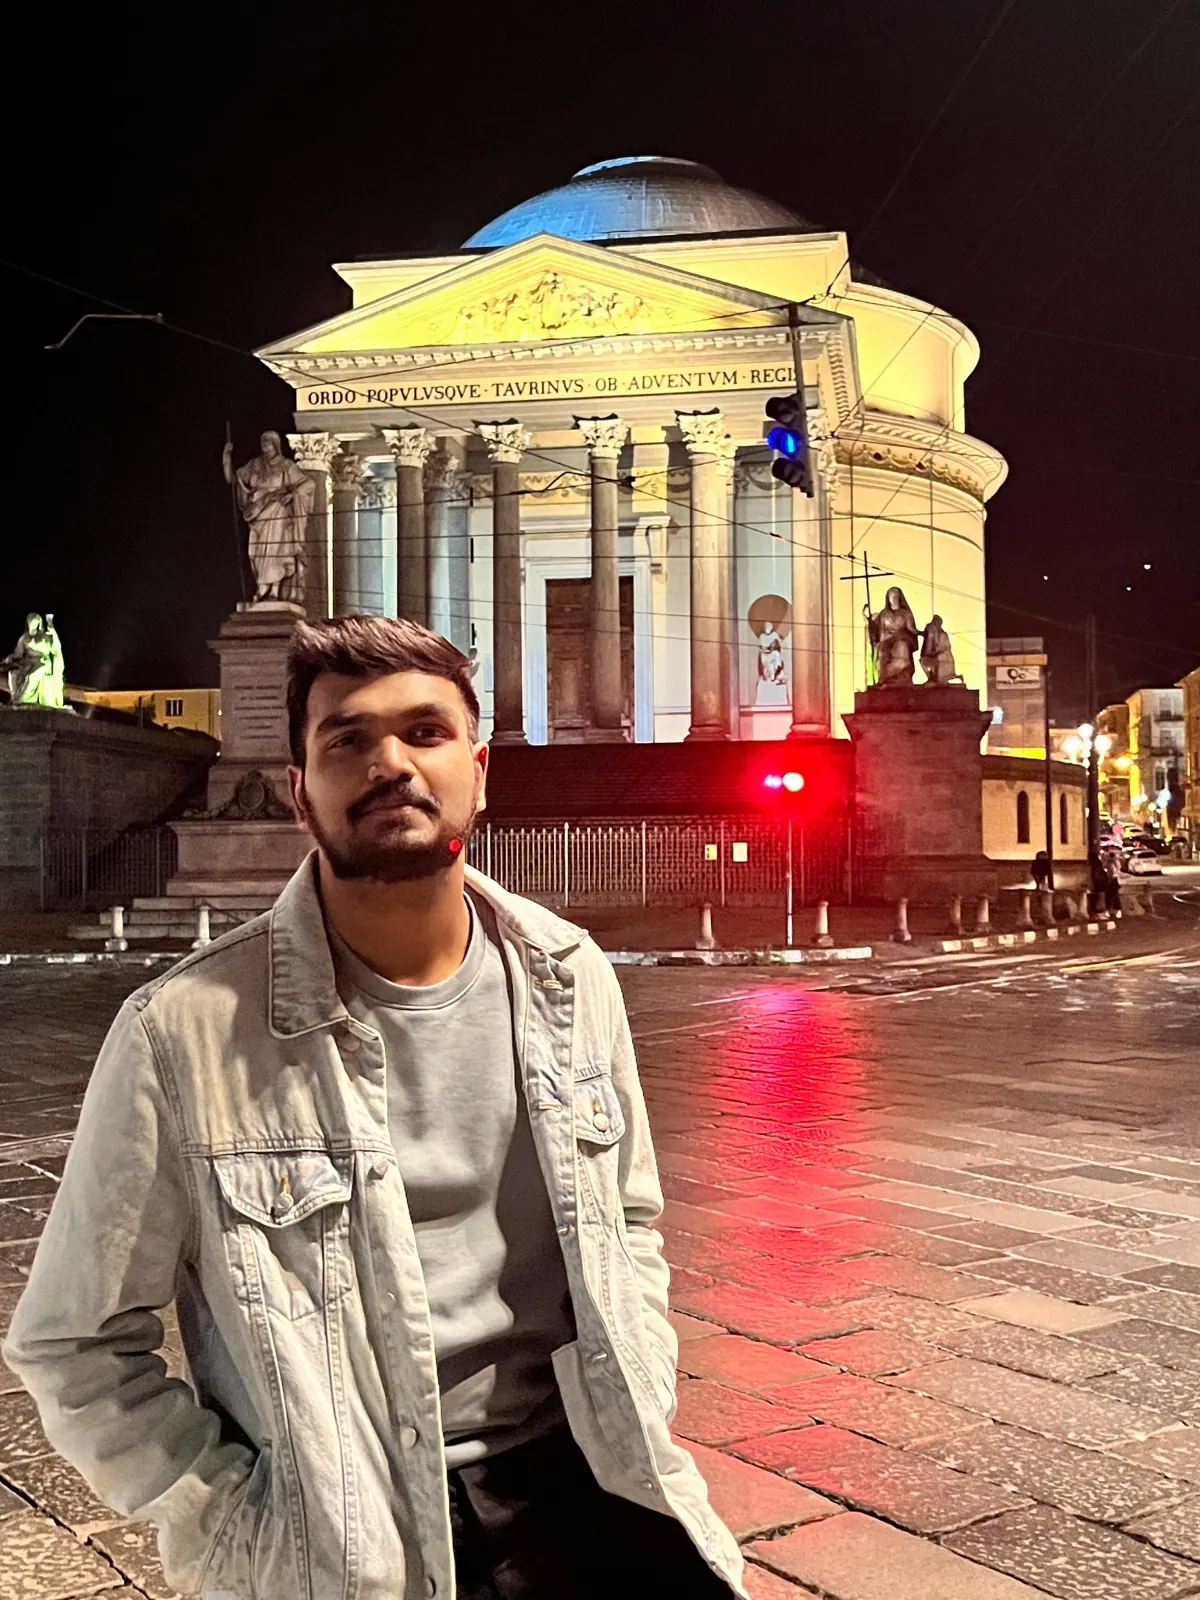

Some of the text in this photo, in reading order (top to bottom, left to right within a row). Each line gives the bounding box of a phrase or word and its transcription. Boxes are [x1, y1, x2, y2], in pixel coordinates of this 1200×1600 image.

[307, 367, 797, 405] ORDO POPVLVSQVE TAVRINVS OB ADVENTVM REGI
